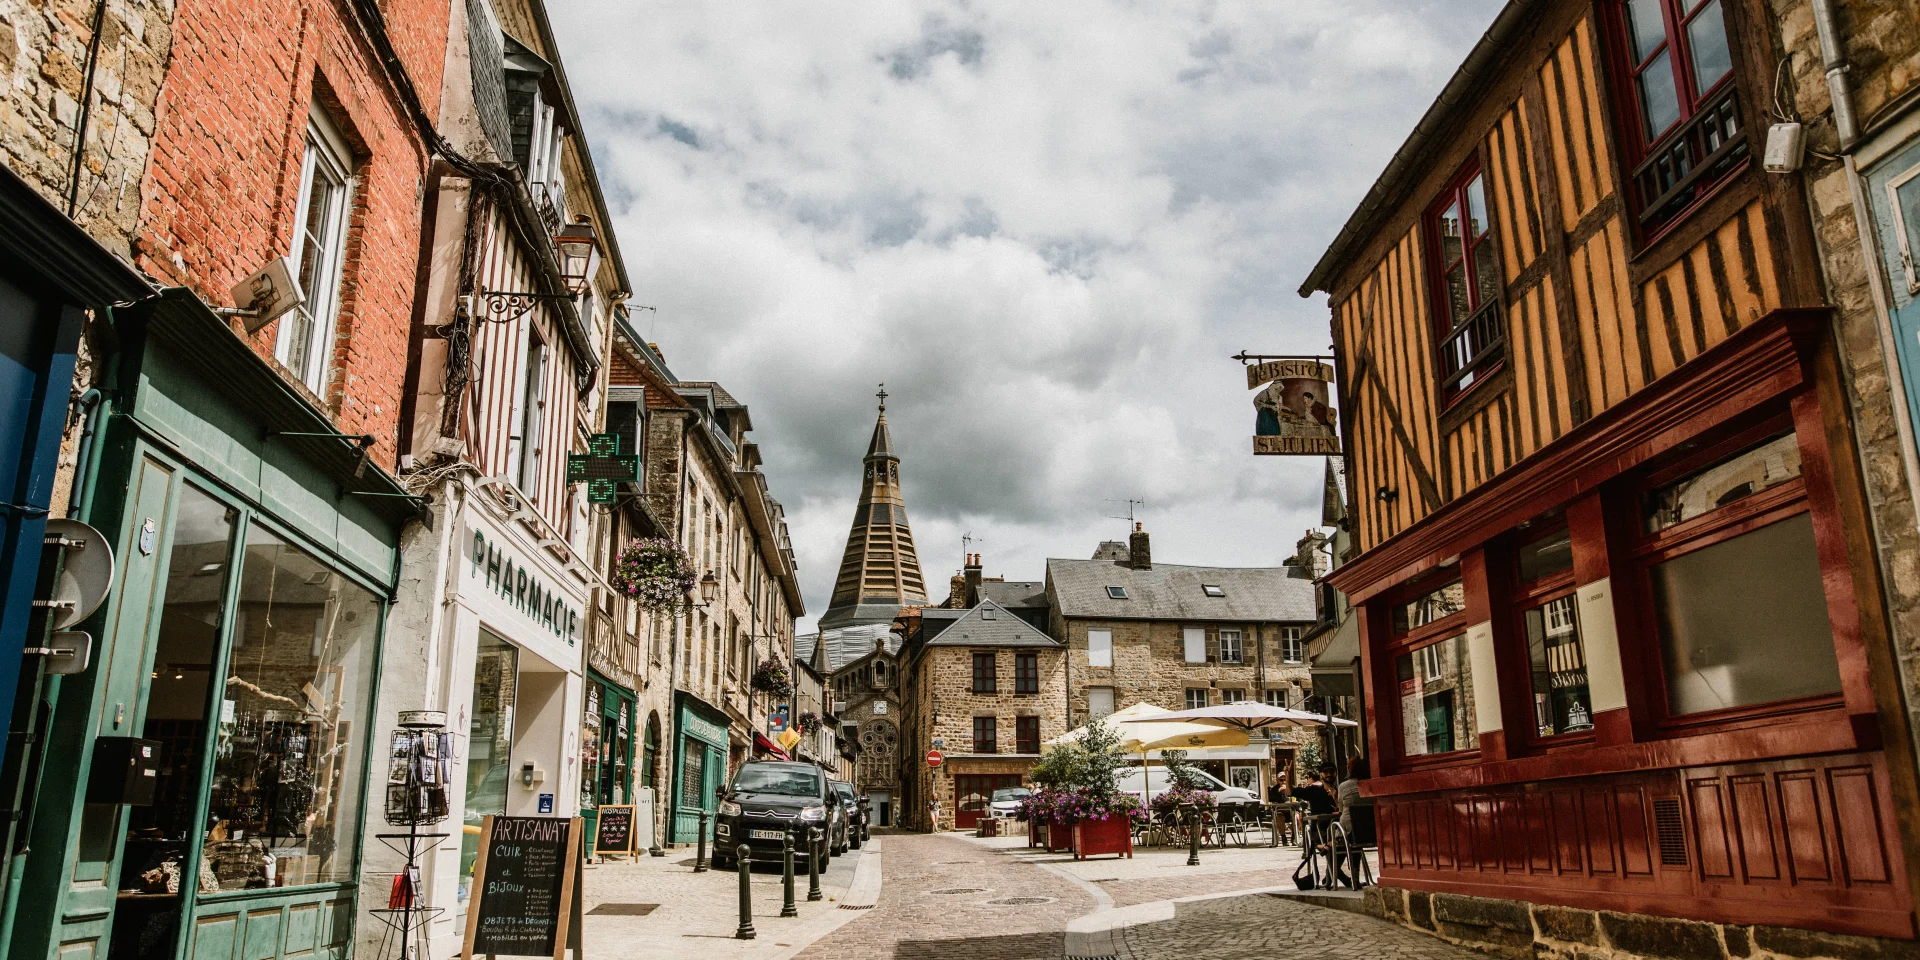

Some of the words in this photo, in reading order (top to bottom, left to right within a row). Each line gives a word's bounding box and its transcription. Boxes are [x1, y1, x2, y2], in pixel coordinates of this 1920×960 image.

[1277, 437, 1336, 453] JULIEN
[471, 527, 577, 648] PHARMACIE
[493, 819, 570, 843] ARTISANAT
[484, 916, 517, 925] OBJETS
